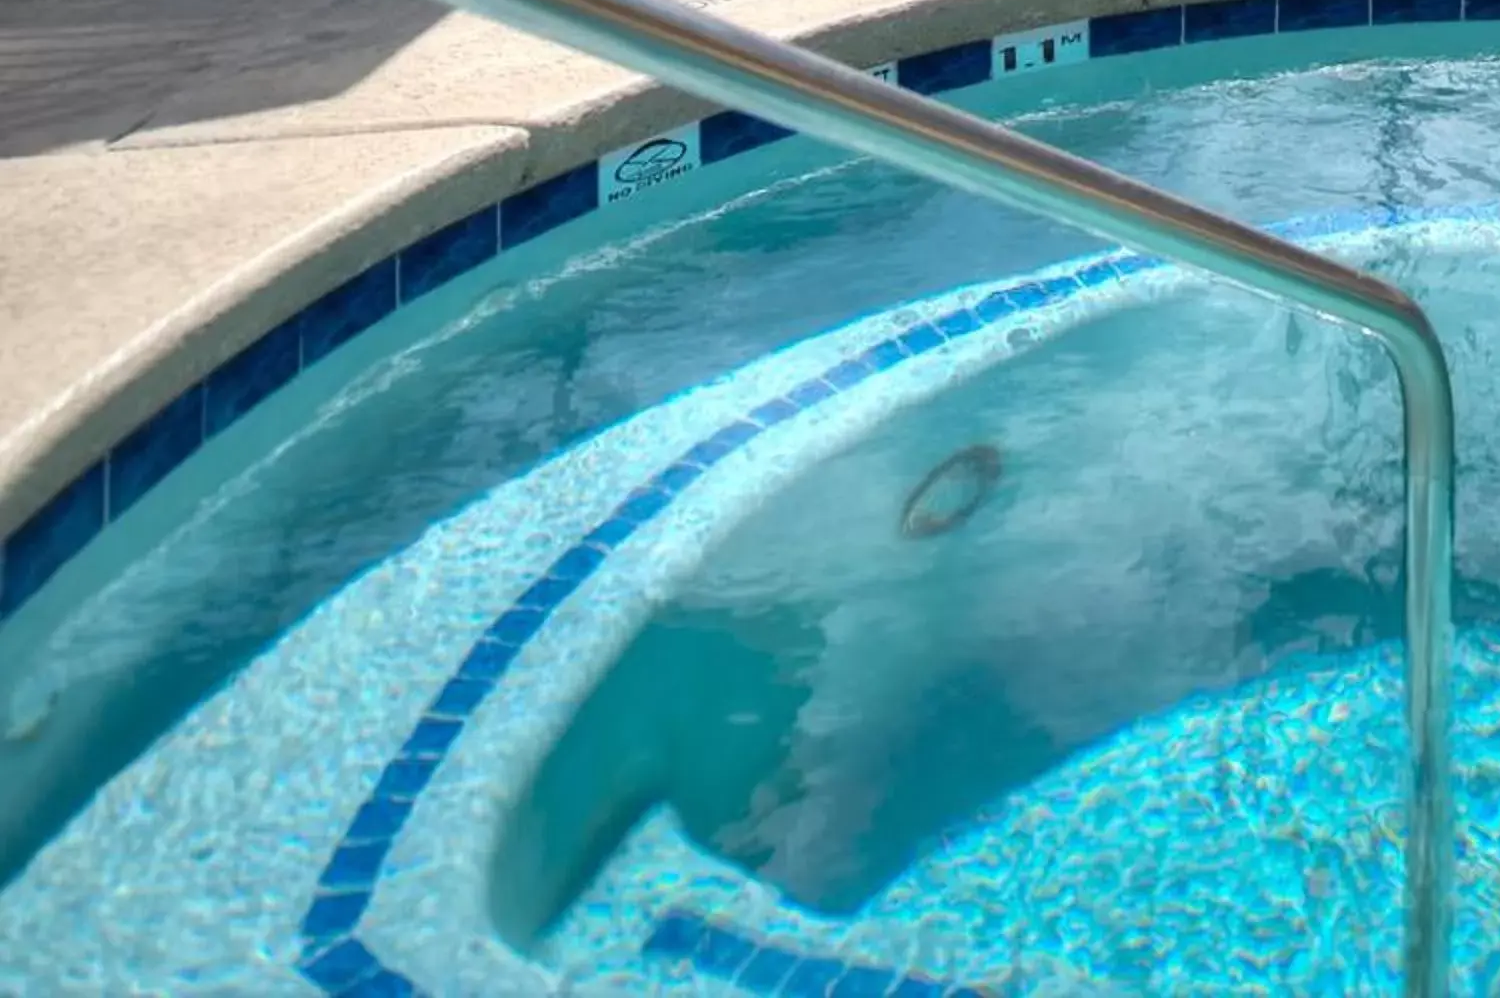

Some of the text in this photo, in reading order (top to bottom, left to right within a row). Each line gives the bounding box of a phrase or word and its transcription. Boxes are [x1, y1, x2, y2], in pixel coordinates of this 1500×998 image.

[999, 32, 1082, 72] 1.1 M
[608, 162, 693, 202] NO DIVING
